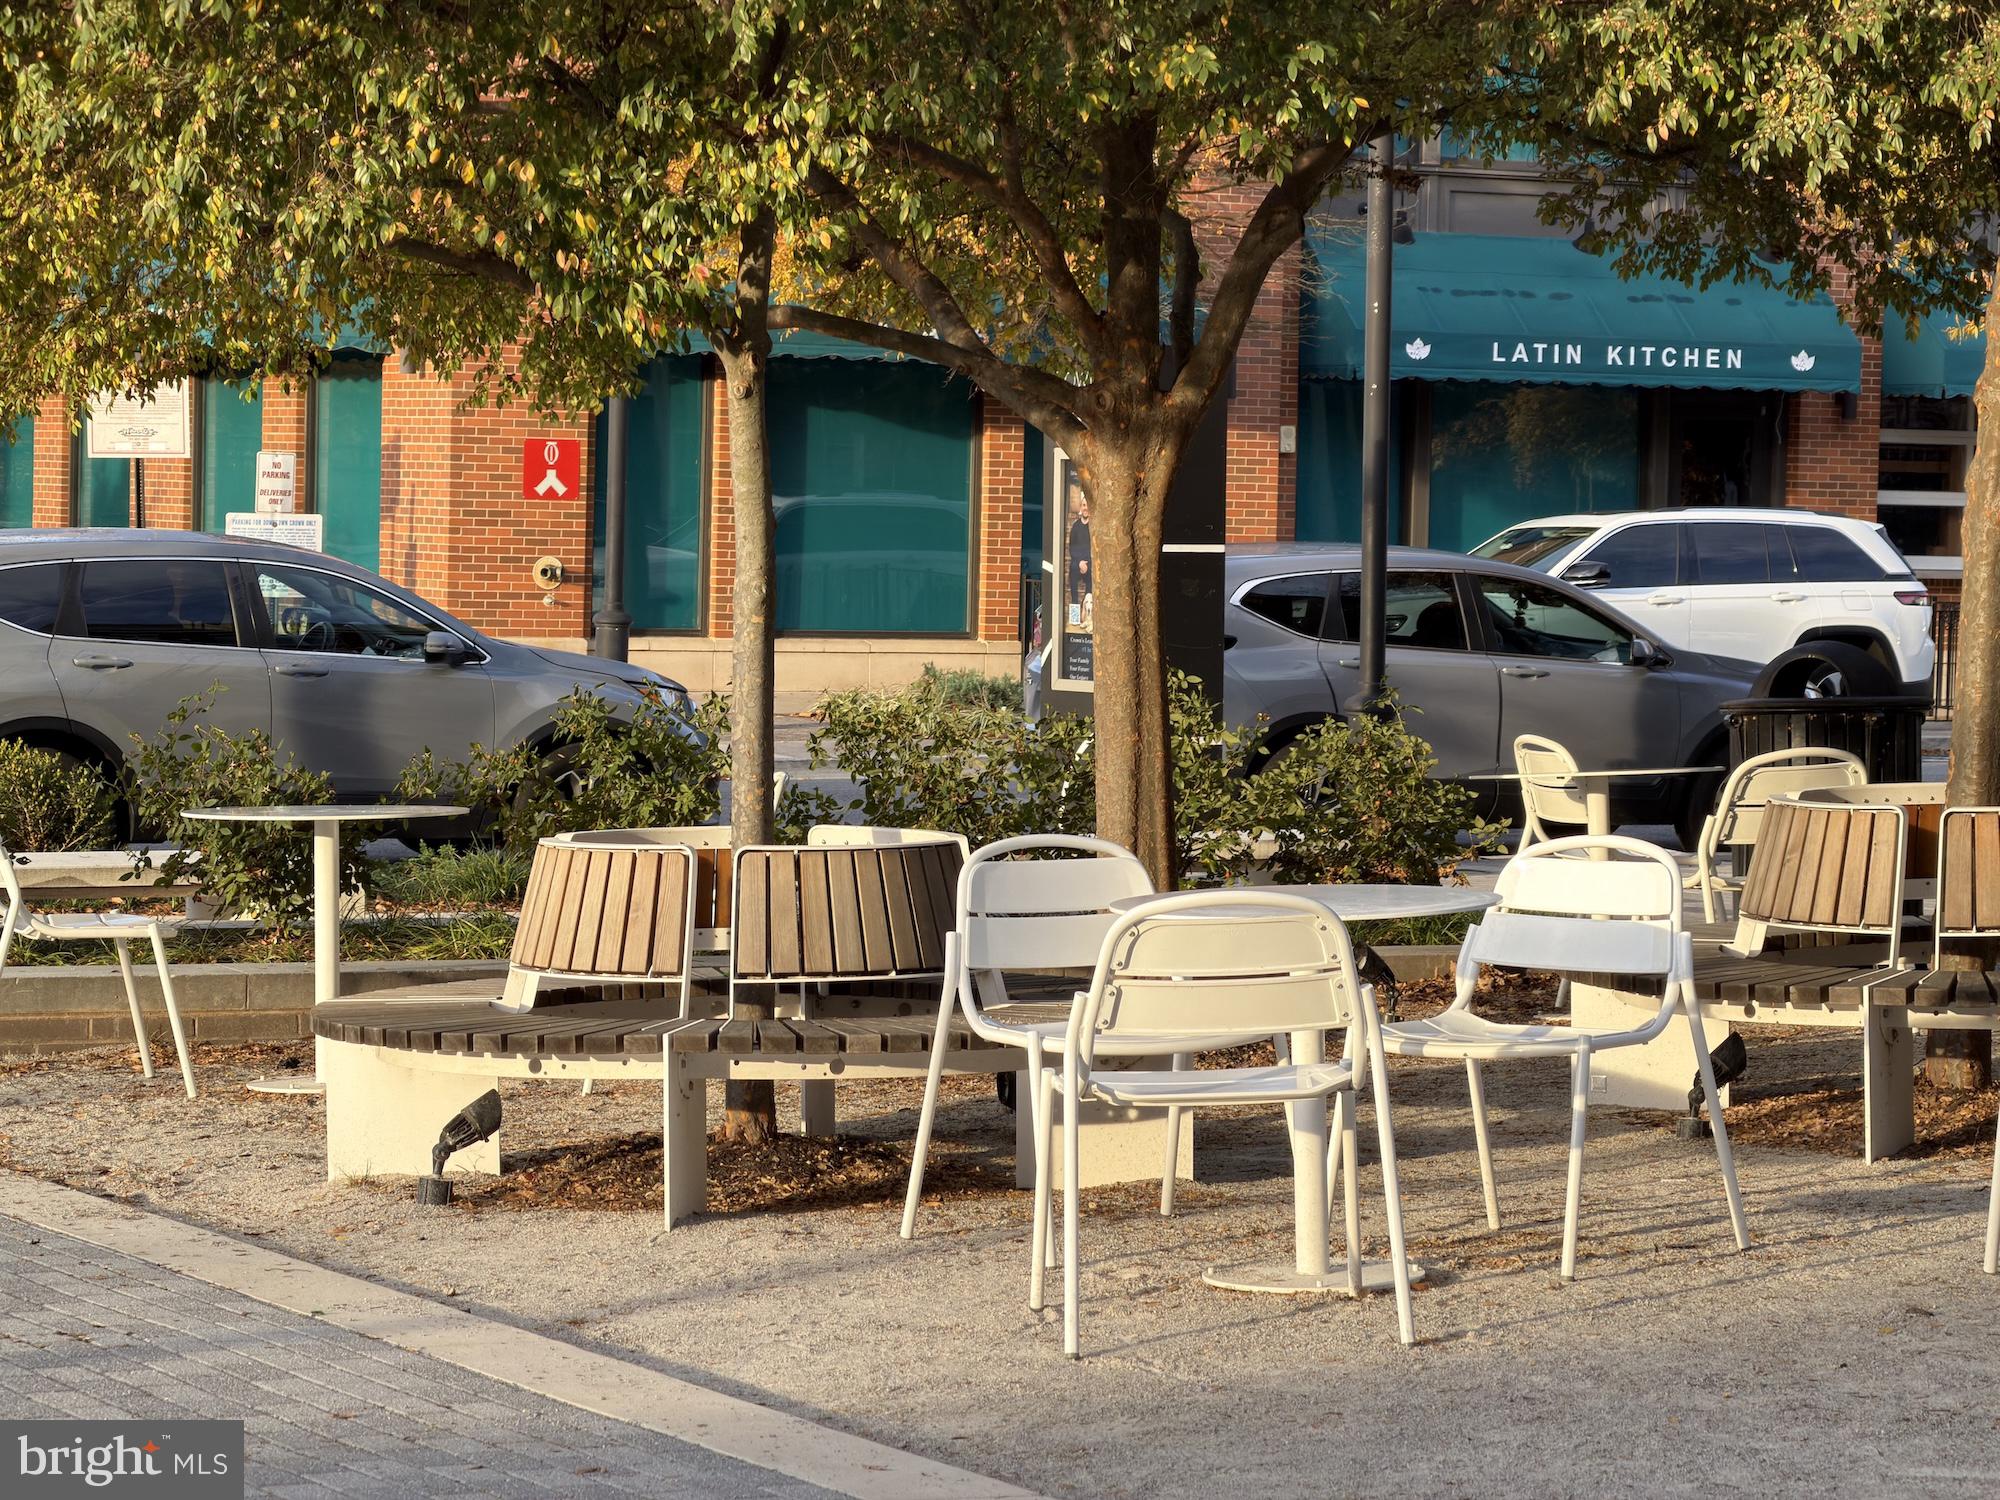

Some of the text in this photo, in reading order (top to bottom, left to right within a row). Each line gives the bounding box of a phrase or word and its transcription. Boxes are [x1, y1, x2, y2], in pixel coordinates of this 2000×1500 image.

[1492, 341, 1743, 370] LATIN KITCHEN
[271, 461, 282, 469] NO
[262, 471, 290, 479] PARKING
[259, 489, 292, 497] DELIVERIES
